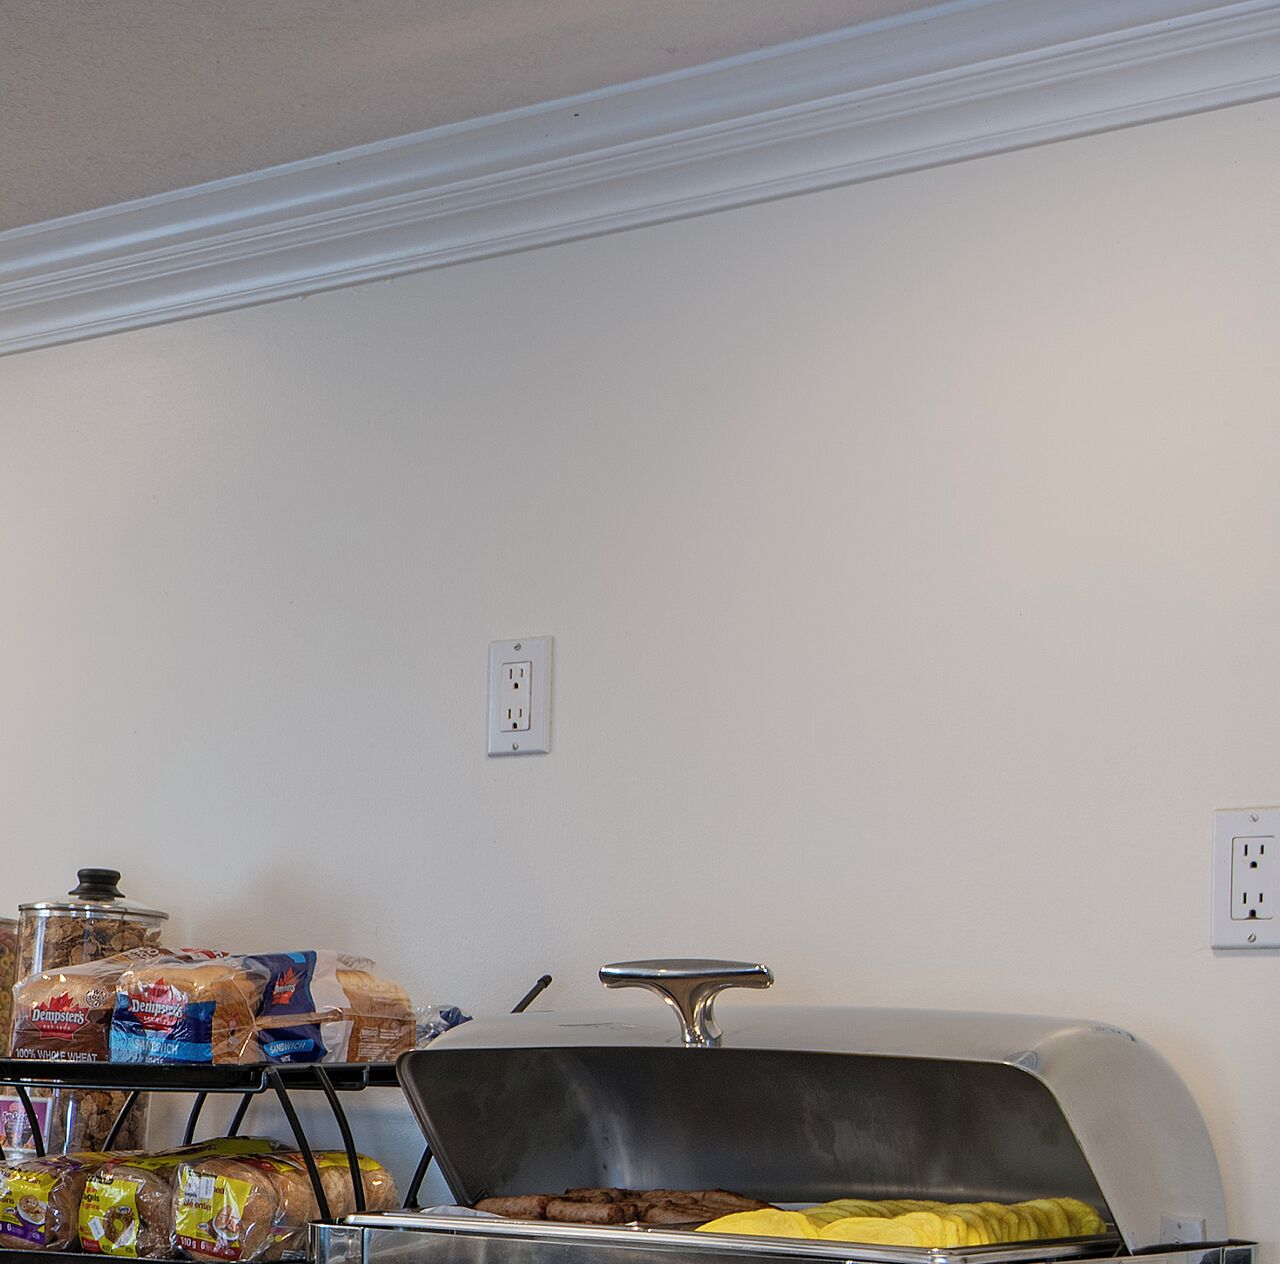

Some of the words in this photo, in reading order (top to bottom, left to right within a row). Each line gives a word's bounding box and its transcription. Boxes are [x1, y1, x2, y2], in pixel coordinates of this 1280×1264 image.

[131, 999, 184, 1019] Dempster's
[31, 1009, 86, 1025] Dempster's
[15, 1048, 36, 1059] 100%
[37, 1050, 66, 1061] WHOLE
[67, 1052, 98, 1063] WHEAT
[269, 1041, 307, 1055] SANDWICH
